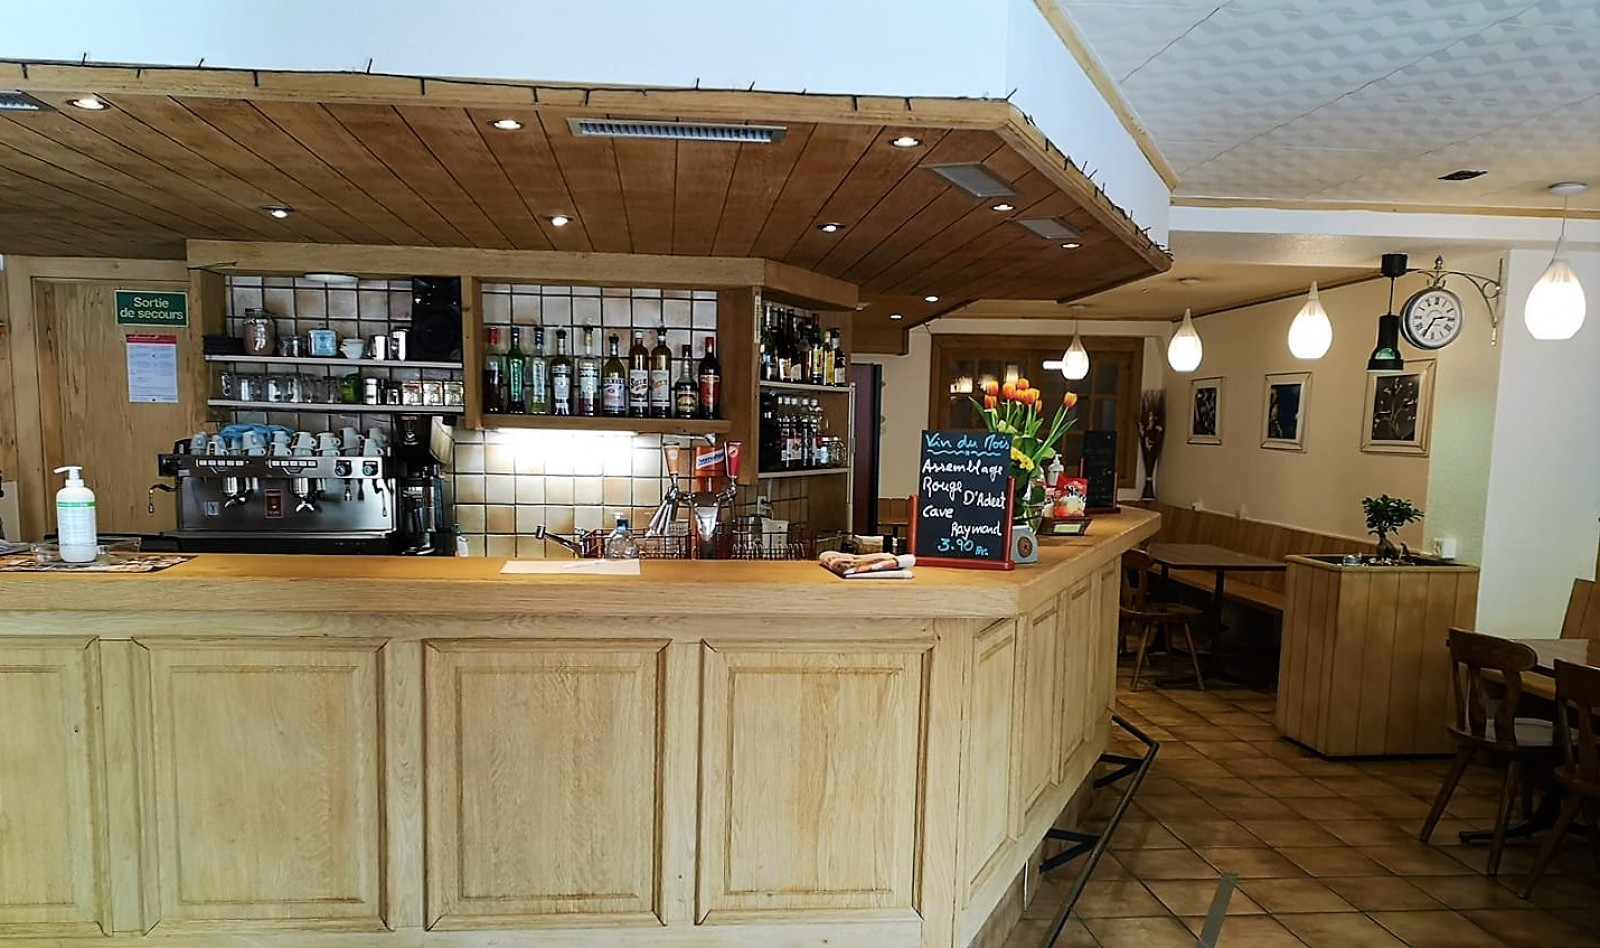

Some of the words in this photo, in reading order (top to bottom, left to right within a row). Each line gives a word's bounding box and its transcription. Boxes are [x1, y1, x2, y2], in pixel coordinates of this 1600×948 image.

[133, 296, 169, 309] Sortie
[120, 307, 135, 318] de
[137, 309, 184, 320] secours
[925, 433, 952, 448] Vin
[957, 434, 978, 448] du
[921, 458, 1003, 482] Assemblage
[922, 476, 962, 501] Rouge
[922, 504, 954, 518] Cave
[950, 521, 1002, 540] Raymond
[937, 537, 974, 552] 3.90
